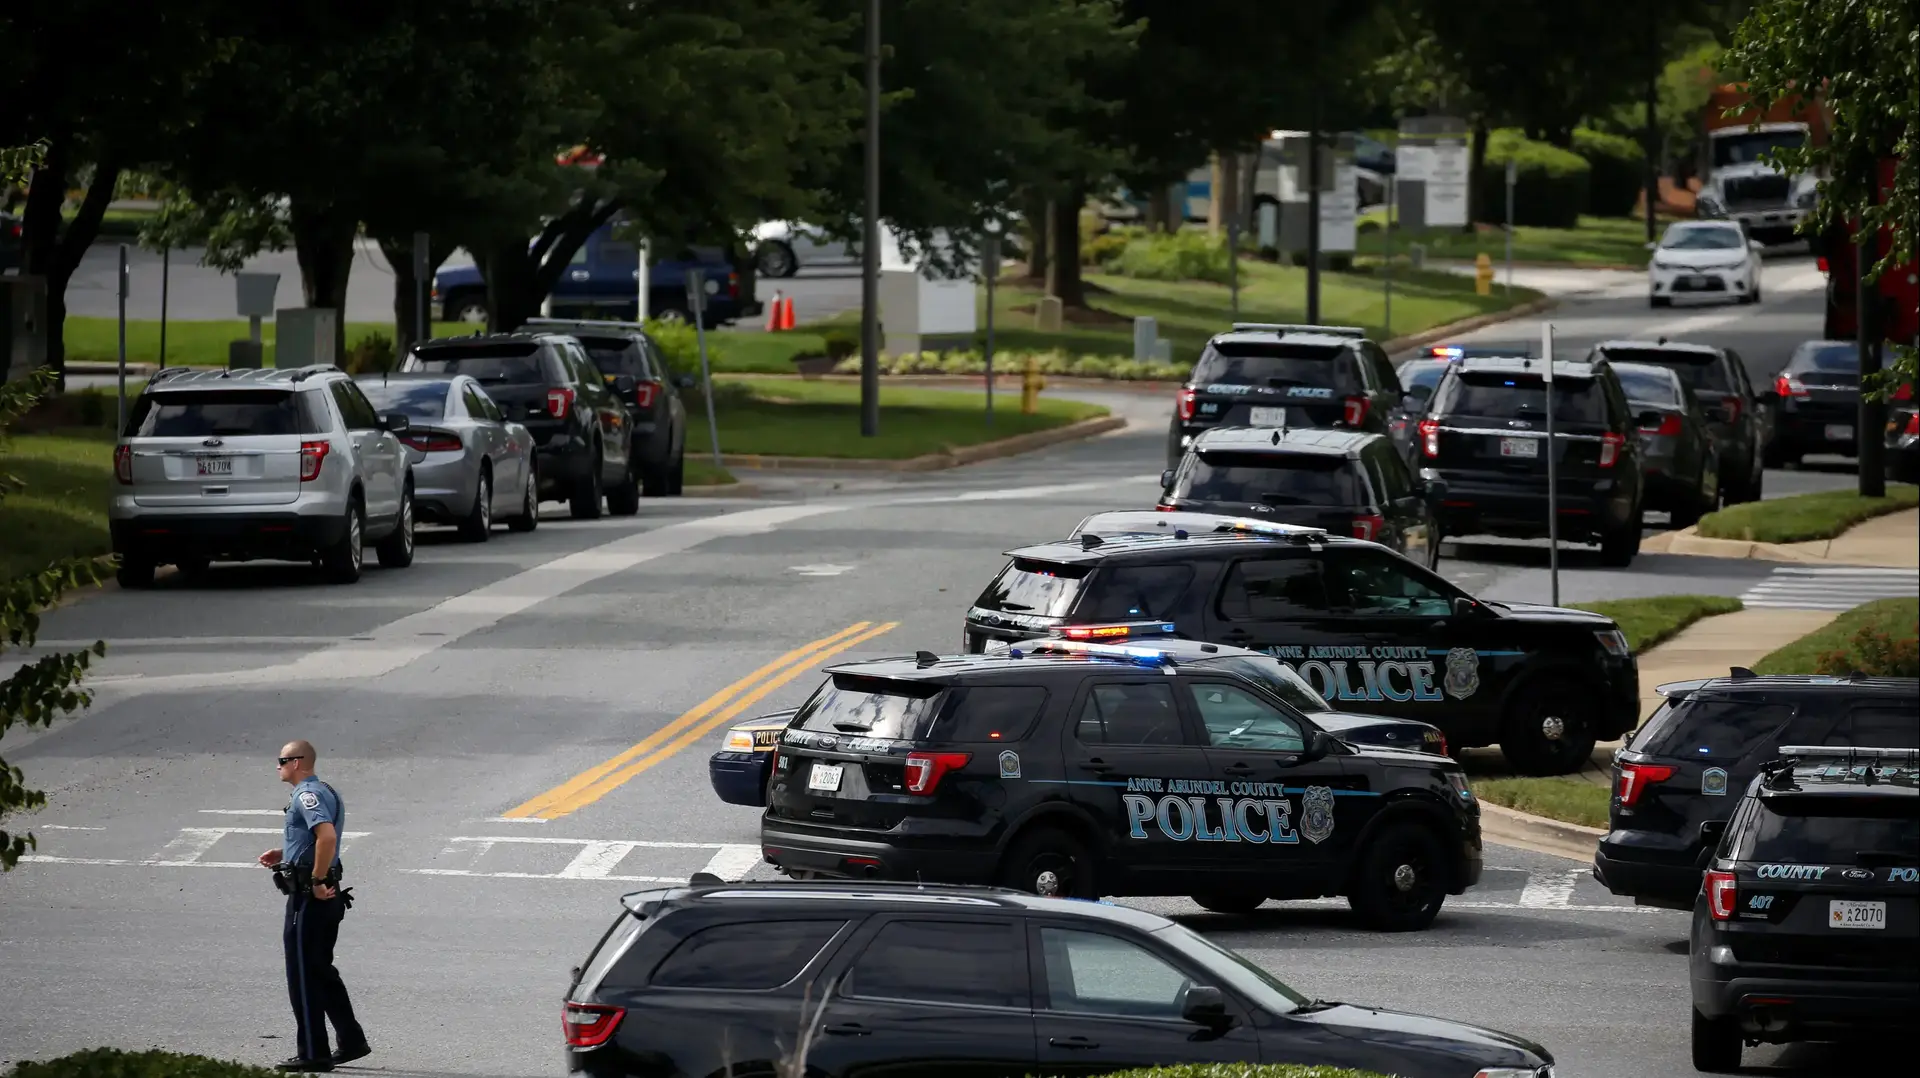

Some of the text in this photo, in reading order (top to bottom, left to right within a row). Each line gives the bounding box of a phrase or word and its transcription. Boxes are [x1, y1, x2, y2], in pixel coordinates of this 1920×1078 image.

[1287, 386, 1334, 399] POLICE
[1268, 646, 1428, 660] ANNE ARUNDEL COUNTY
[1283, 660, 1444, 702] OLICE
[1127, 777, 1285, 797] ANNE ARUNDEL COUNTY
[1122, 793, 1300, 844] POLICE
[1757, 864, 1830, 880] COUNTY
[1887, 867, 1919, 882] PO
[1749, 895, 1775, 909] 407
[1854, 907, 1883, 923] 2070
